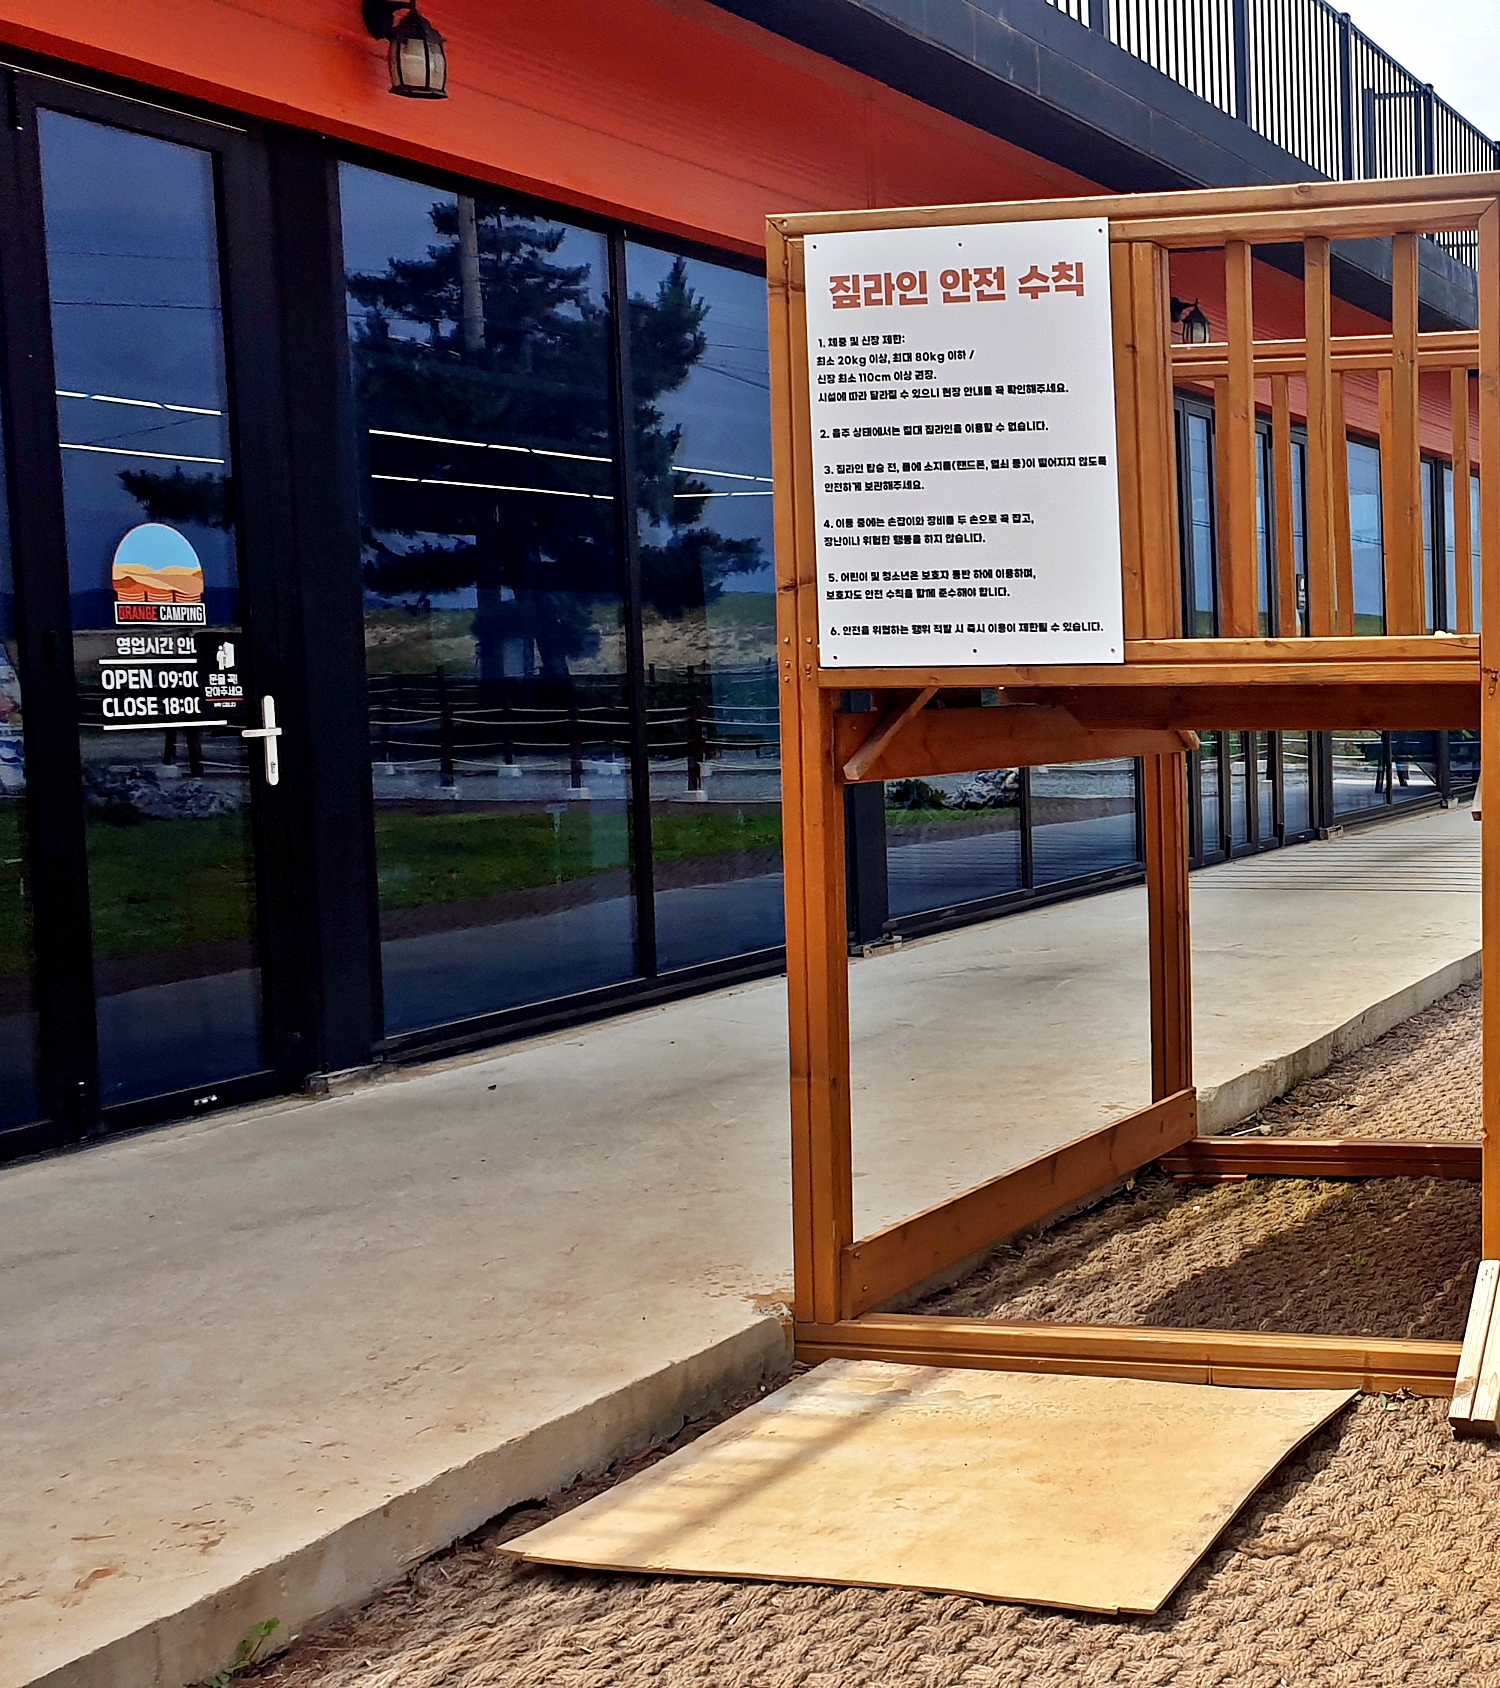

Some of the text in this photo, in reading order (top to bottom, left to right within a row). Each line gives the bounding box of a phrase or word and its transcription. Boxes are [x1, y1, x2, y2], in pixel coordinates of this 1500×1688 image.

[829, 261, 1085, 310] 짚라인 안전 수칙
[818, 338, 826, 348] 1.
[849, 336, 859, 347] 및
[861, 335, 880, 346] 신장
[881, 333, 906, 345] 제한:
[816, 356, 836, 367] 최소
[837, 355, 867, 368] 20kg
[868, 353, 891, 365] 이상,
[892, 352, 913, 363] 최대
[915, 351, 945, 364] 80kg
[947, 349, 967, 361] 이하
[817, 373, 836, 385] 신장
[837, 373, 857, 384] 최소
[858, 372, 892, 383] 110cm
[893, 370, 913, 381] 이상
[818, 382, 1069, 403] 시설에 따라 달라질 수 있으니 현장 안내를 꼭 확인해주세요.
[819, 420, 1049, 439] 2. 음주 상태에서는 절대 짚라인을 이용할 수 없습니다.
[823, 465, 834, 475] 3.
[835, 463, 864, 475] 짚라인
[866, 462, 885, 474] 탑승
[887, 462, 900, 474] 전,
[1011, 457, 1036, 469] 등)이
[1078, 455, 1107, 467] 않도록
[824, 479, 925, 493] 안전하게 보관해주세요.
[823, 513, 1035, 529] 4. 이동 중에는 손잡이와 장비를 두 손으로 꼭 잡고,
[823, 535, 861, 547] 장난이나
[923, 533, 943, 544] 하지
[944, 532, 986, 544] 않습니다.
[828, 568, 1037, 583] 5. 어린이 및 청소년은 보호자 동반 하에 이용하며,
[826, 586, 1011, 601] 보호자도 안전 수칙을 함께 준수해야 합니다.
[118, 606, 203, 622] ORANGE CAMPING
[830, 626, 841, 636] 6.
[842, 625, 870, 636] 안전을
[911, 624, 931, 635] 행위
[954, 623, 964, 634] 시
[966, 623, 986, 634] 즉시
[987, 622, 1016, 634] 이용이
[1050, 622, 1061, 633] 수
[1062, 621, 1104, 632] 있습니다.
[116, 636, 174, 655] 영업시간
[101, 669, 154, 690] OPEN
[102, 696, 158, 717] CLOSE
